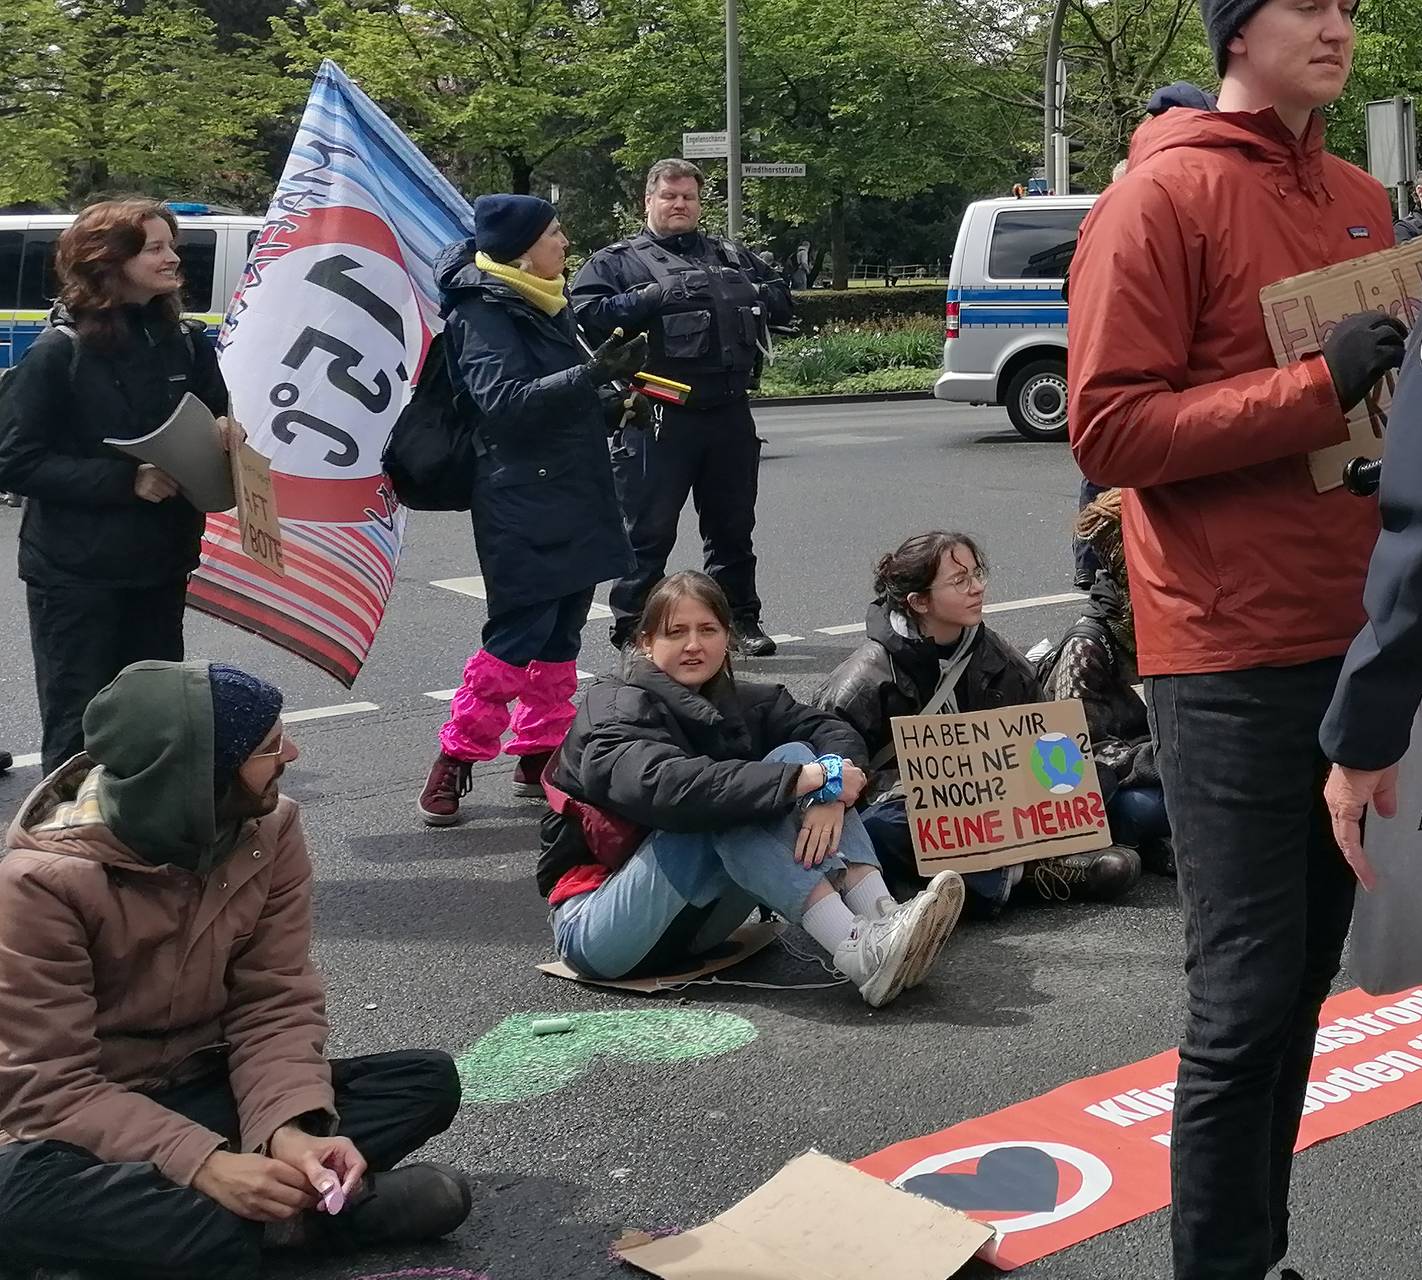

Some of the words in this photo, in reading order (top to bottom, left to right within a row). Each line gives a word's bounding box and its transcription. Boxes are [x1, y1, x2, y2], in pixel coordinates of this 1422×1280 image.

[745, 165, 803, 175] Windthorststraße
[901, 720, 990, 750] HABEN
[998, 712, 1047, 738] WIR
[907, 754, 973, 781] NOCH
[982, 743, 1020, 773] NE
[912, 786, 928, 810] 2
[931, 776, 1007, 809] NOCH?
[916, 810, 1005, 853] KEINE
[1012, 791, 1106, 840] MEHR?
